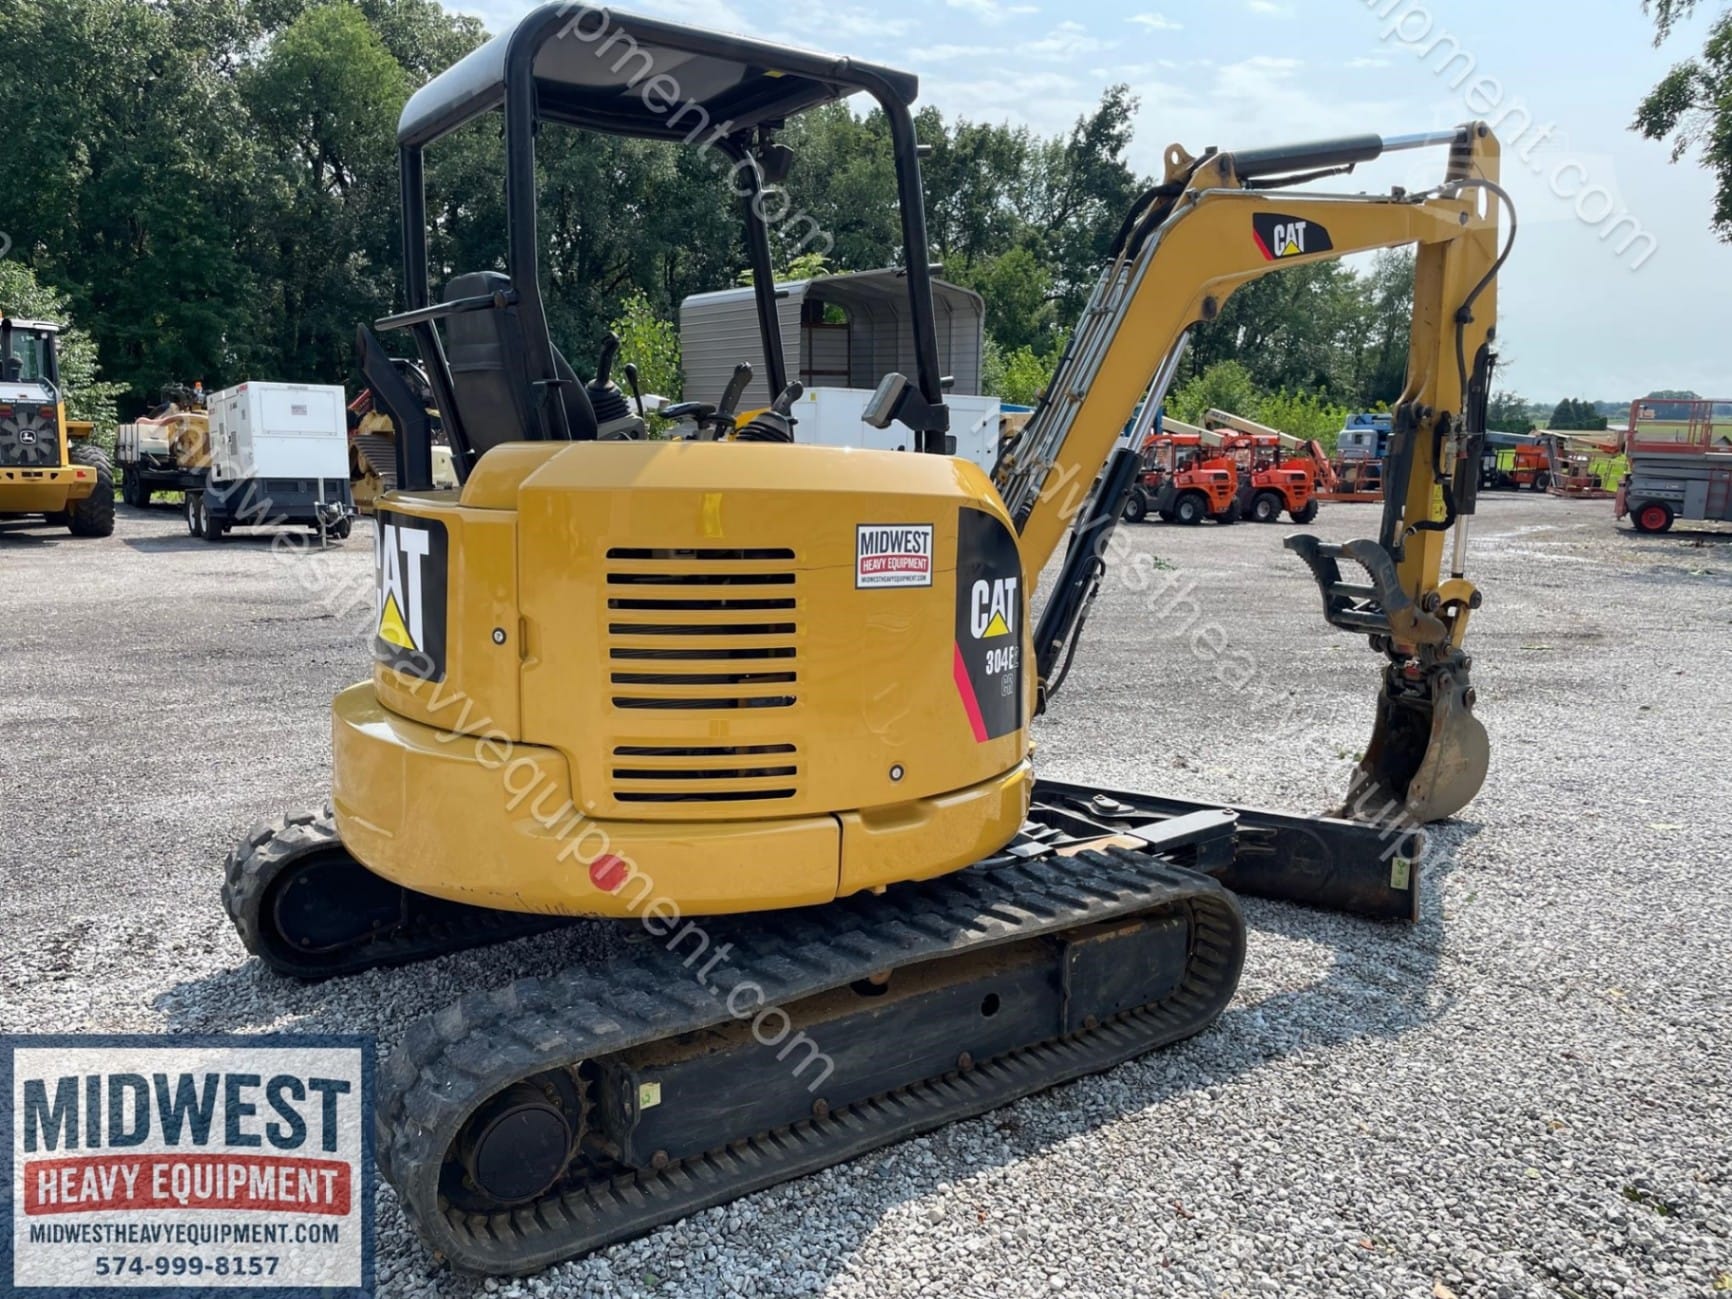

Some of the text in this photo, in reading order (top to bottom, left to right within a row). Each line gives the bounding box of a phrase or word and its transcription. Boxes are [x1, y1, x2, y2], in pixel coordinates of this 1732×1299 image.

[1273, 221, 1306, 257] CAT
[860, 530, 929, 555] MIDWEST
[863, 557, 926, 572] HEAVY EQUIPMENT
[375, 518, 430, 653] AT
[970, 577, 1016, 639] CAT
